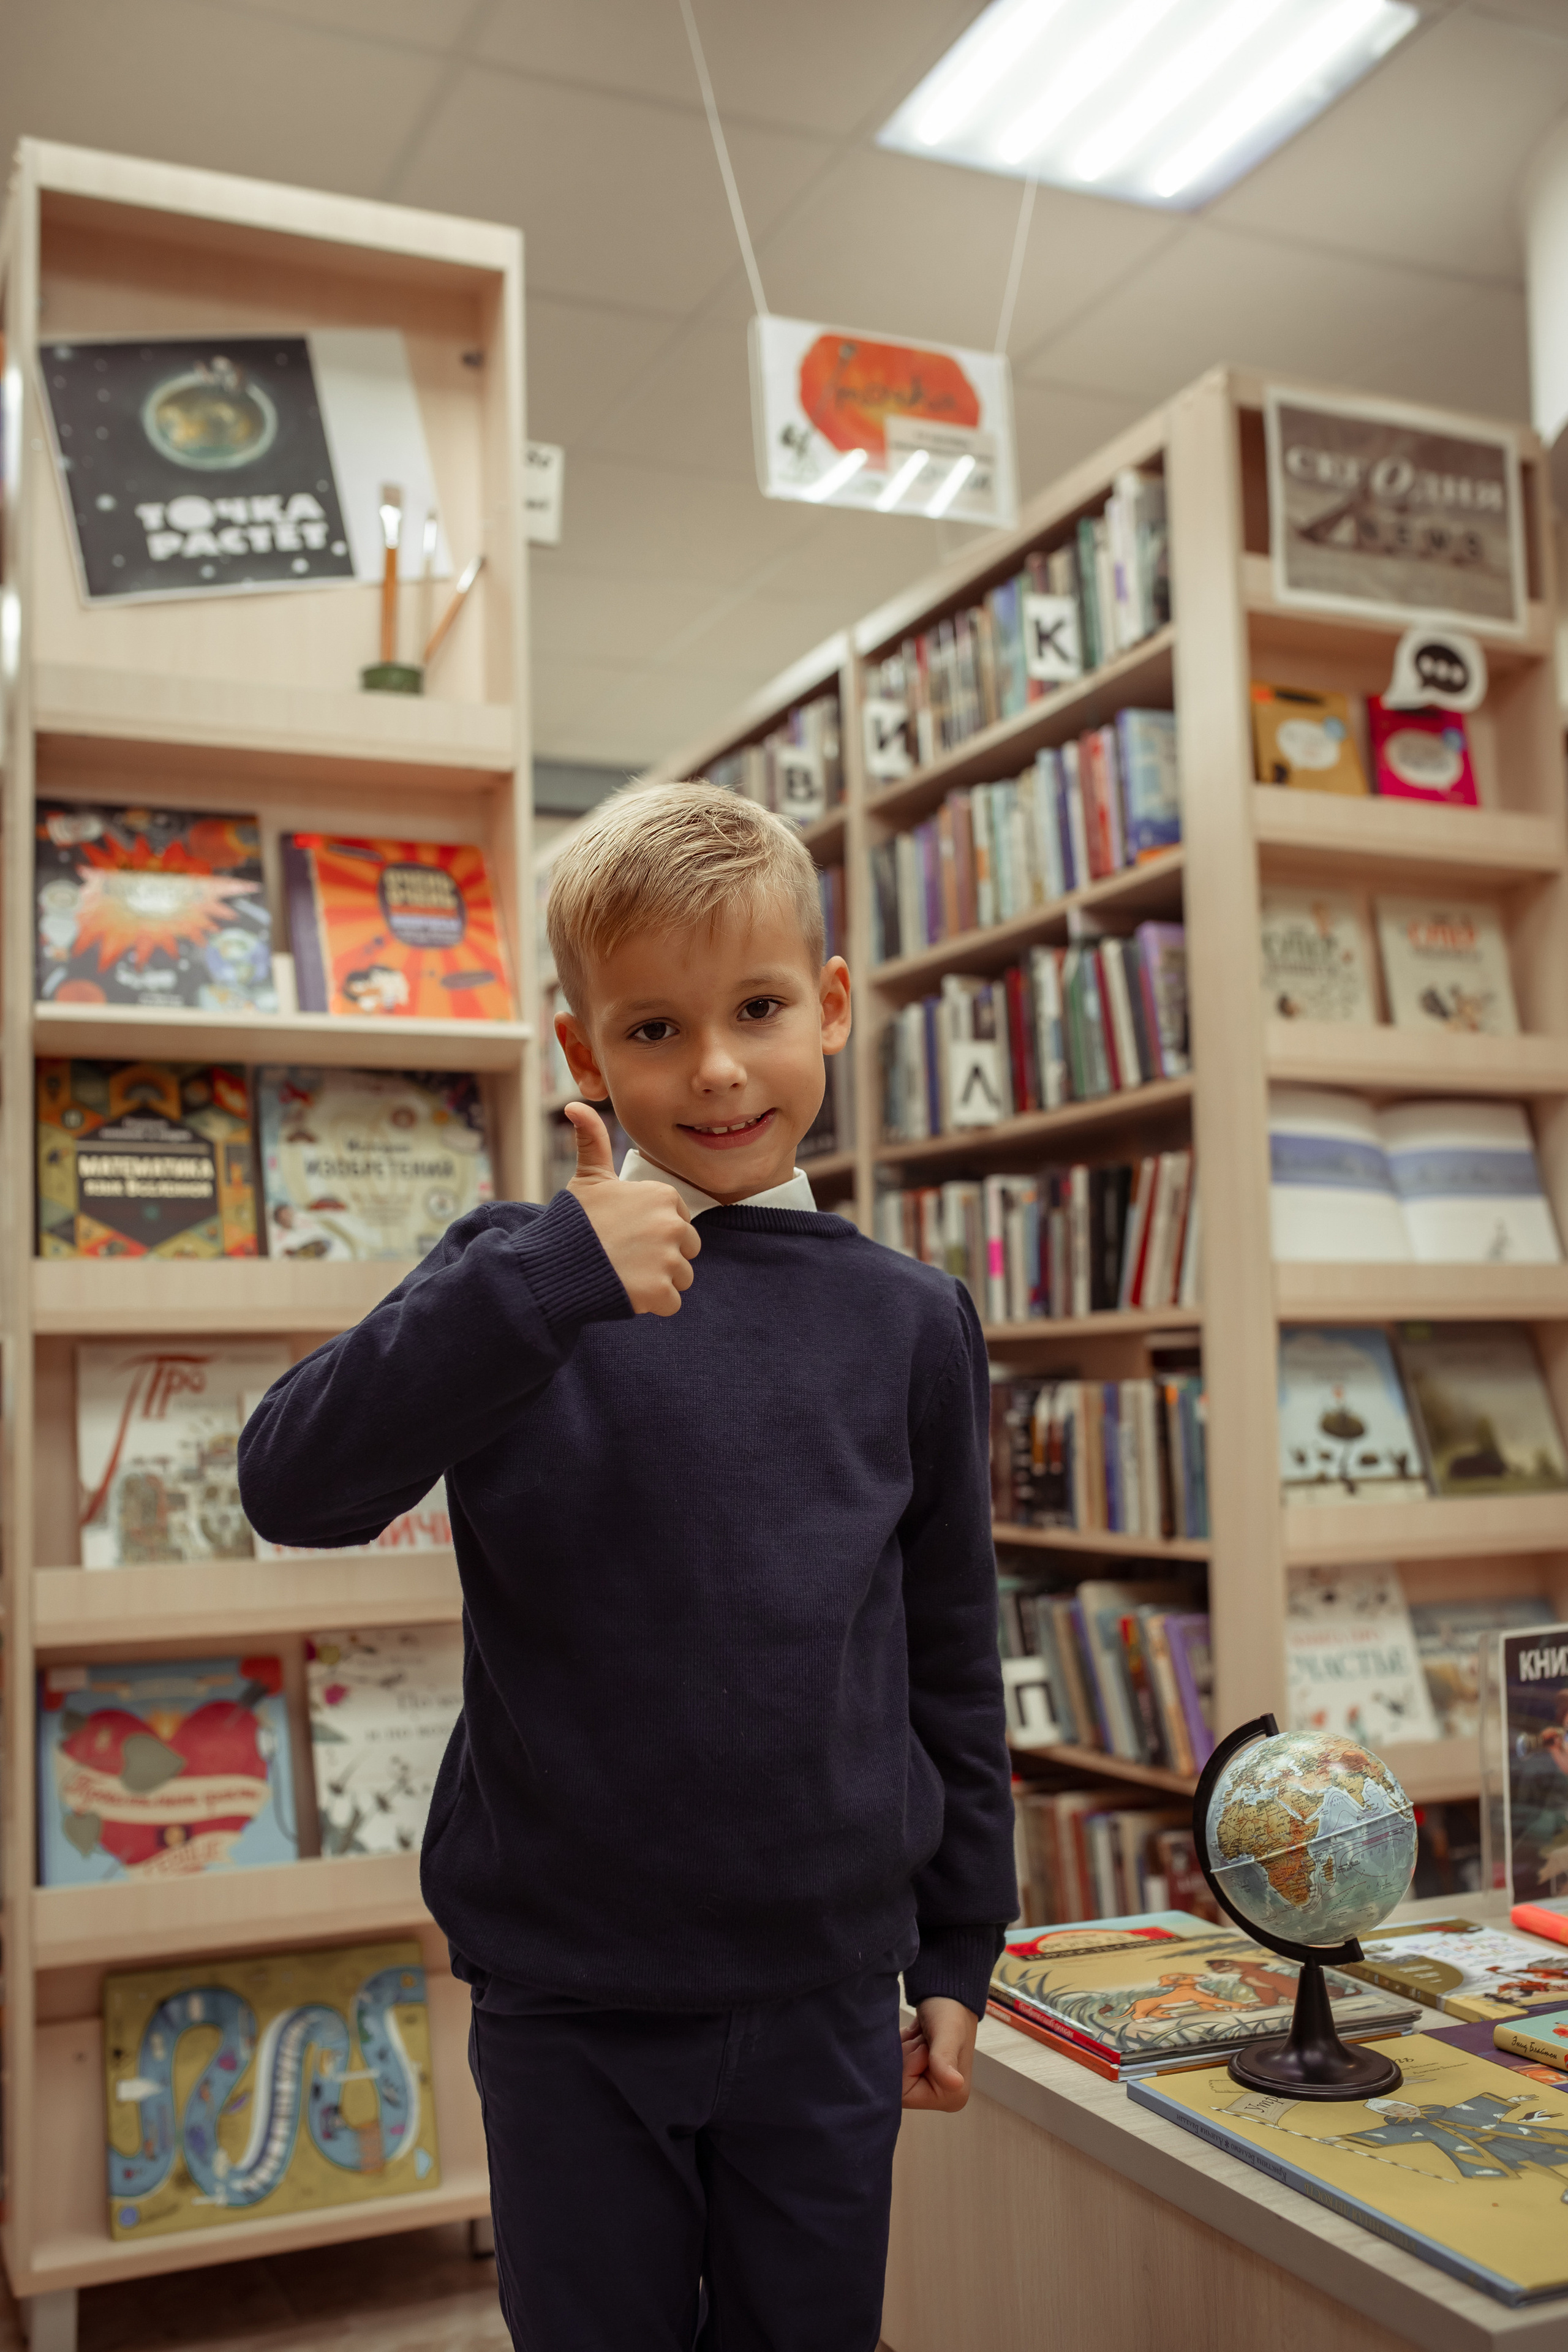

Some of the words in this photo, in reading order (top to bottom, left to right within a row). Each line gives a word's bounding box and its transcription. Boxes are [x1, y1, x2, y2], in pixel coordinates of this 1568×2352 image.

[134, 492, 326, 532] ТОЧКА
[78, 1155, 214, 1179] МАТЕМАТИКА
[1518, 1646, 1568, 1682] КНИ
[1244, 2095, 1285, 2113] Утр
